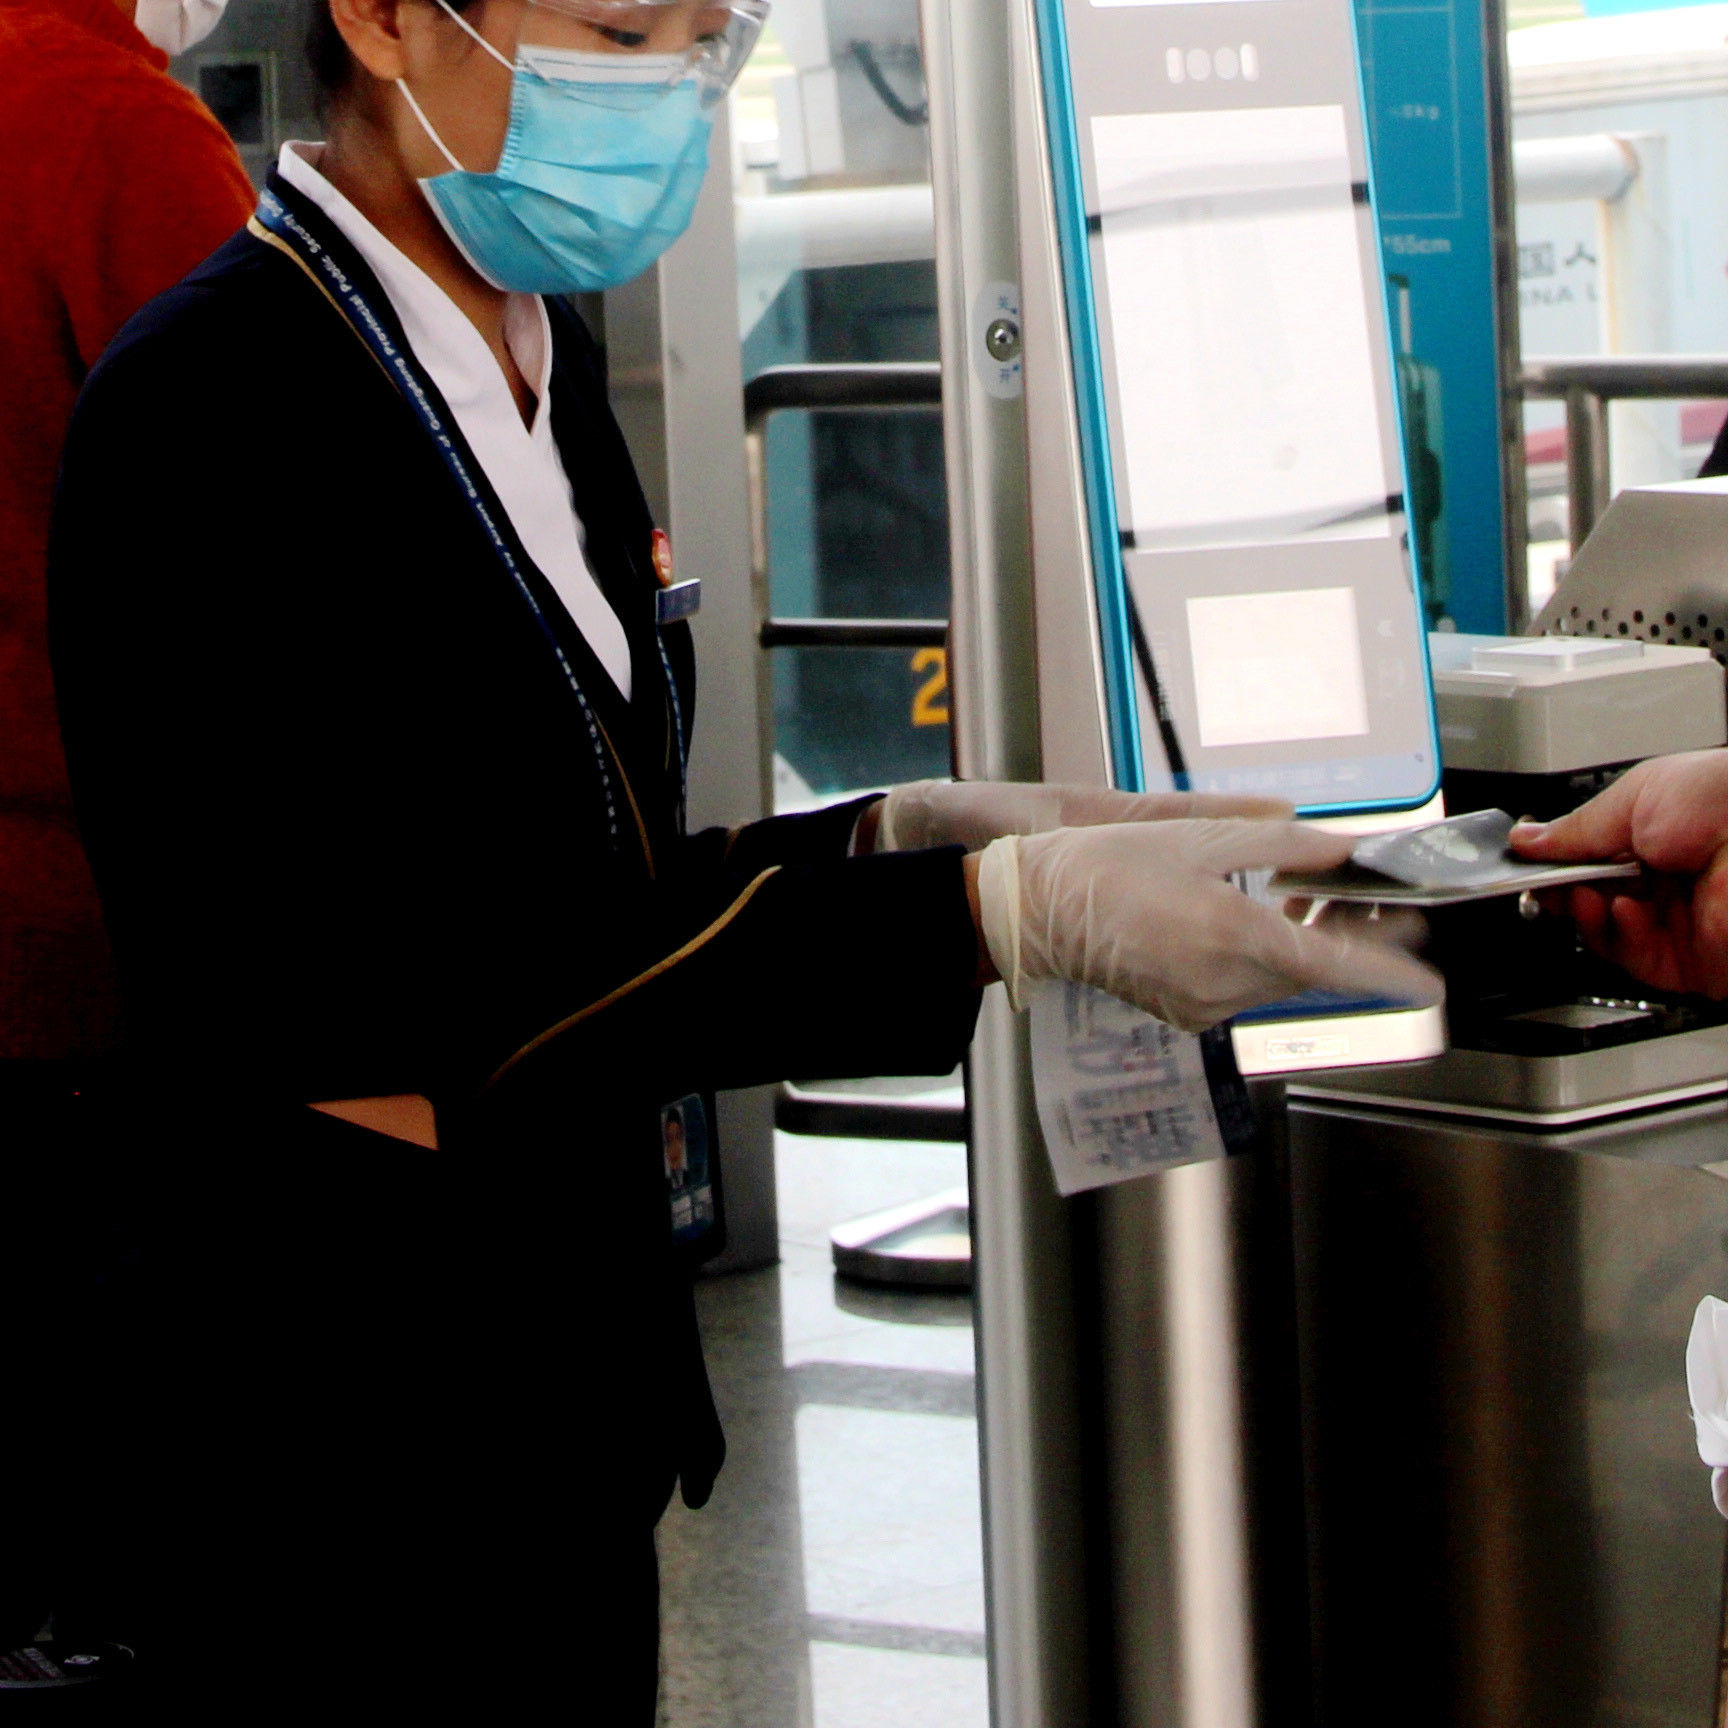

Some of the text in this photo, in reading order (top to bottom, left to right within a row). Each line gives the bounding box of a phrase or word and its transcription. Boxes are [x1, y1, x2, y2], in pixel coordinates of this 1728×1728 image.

[282, 213, 322, 254] Security
[322, 254, 353, 293] Public
[349, 293, 396, 356] Provincial
[394, 357, 441, 431] Guangdong
